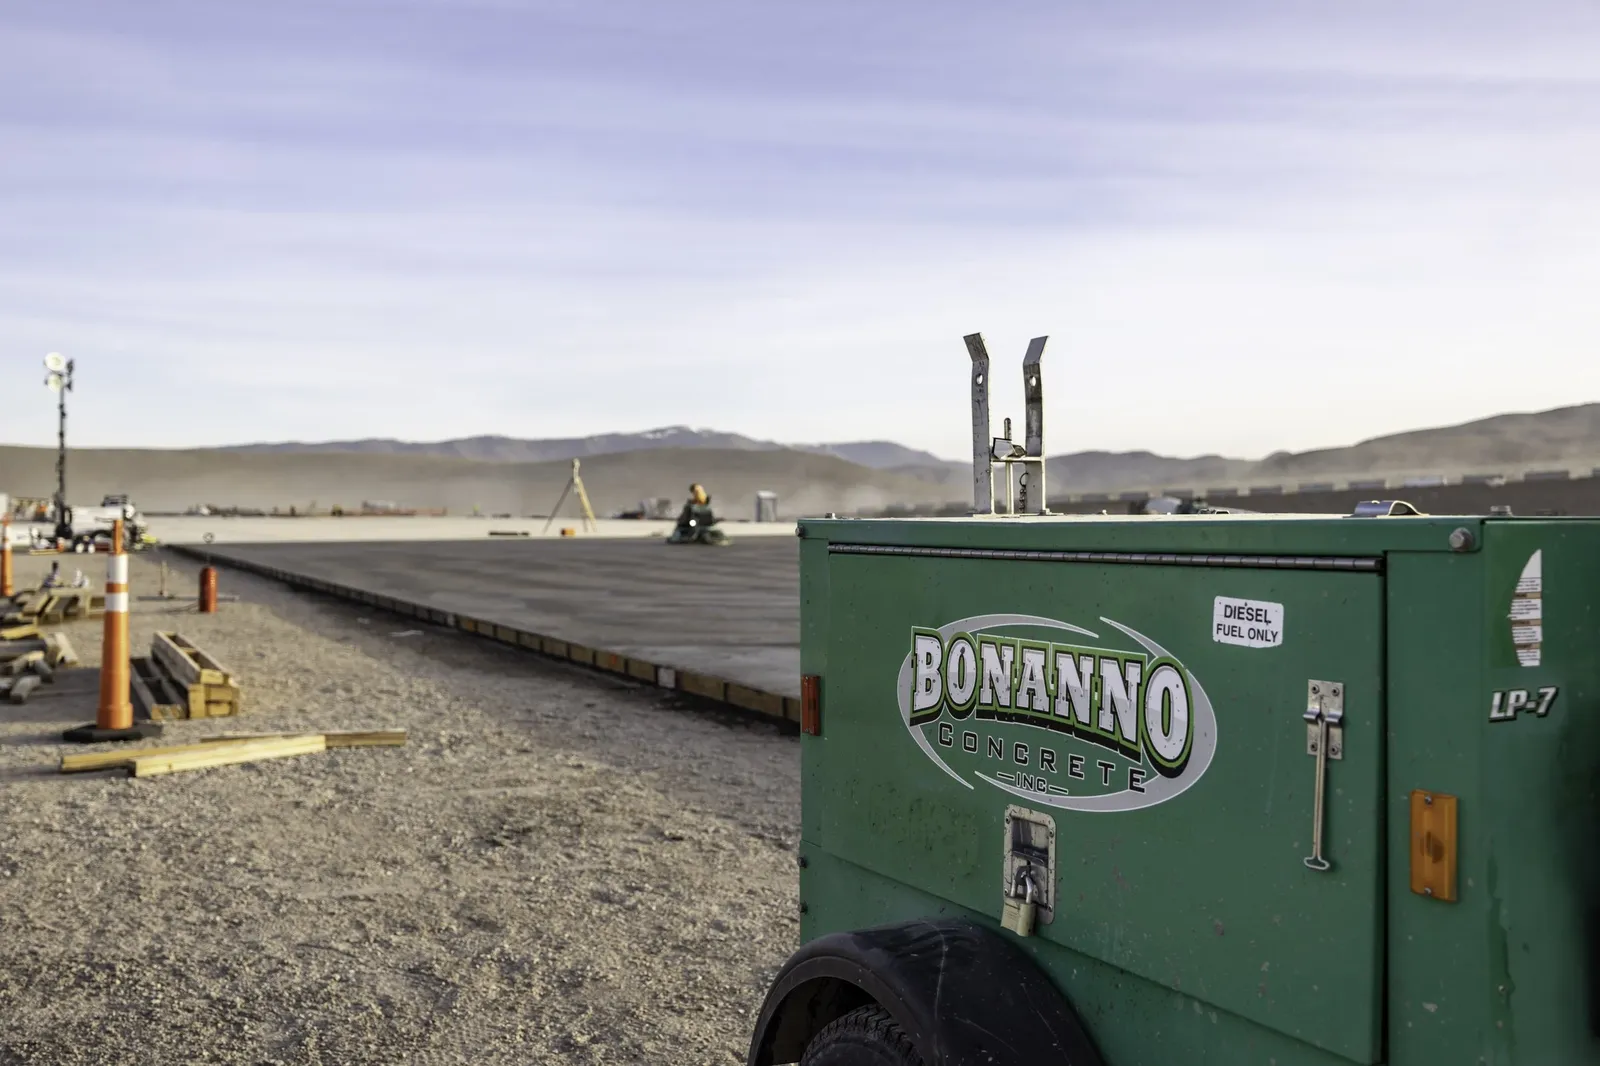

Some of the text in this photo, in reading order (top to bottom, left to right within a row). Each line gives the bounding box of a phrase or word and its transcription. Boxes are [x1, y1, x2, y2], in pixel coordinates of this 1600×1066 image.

[1224, 604, 1272, 624] DIESEL
[1216, 623, 1279, 643] FUEL ONLY
[910, 627, 1193, 776] BONANNO
[1490, 686, 1557, 721] LP-7
[938, 722, 1146, 793] CONCRETE
[1016, 772, 1048, 793] INC
